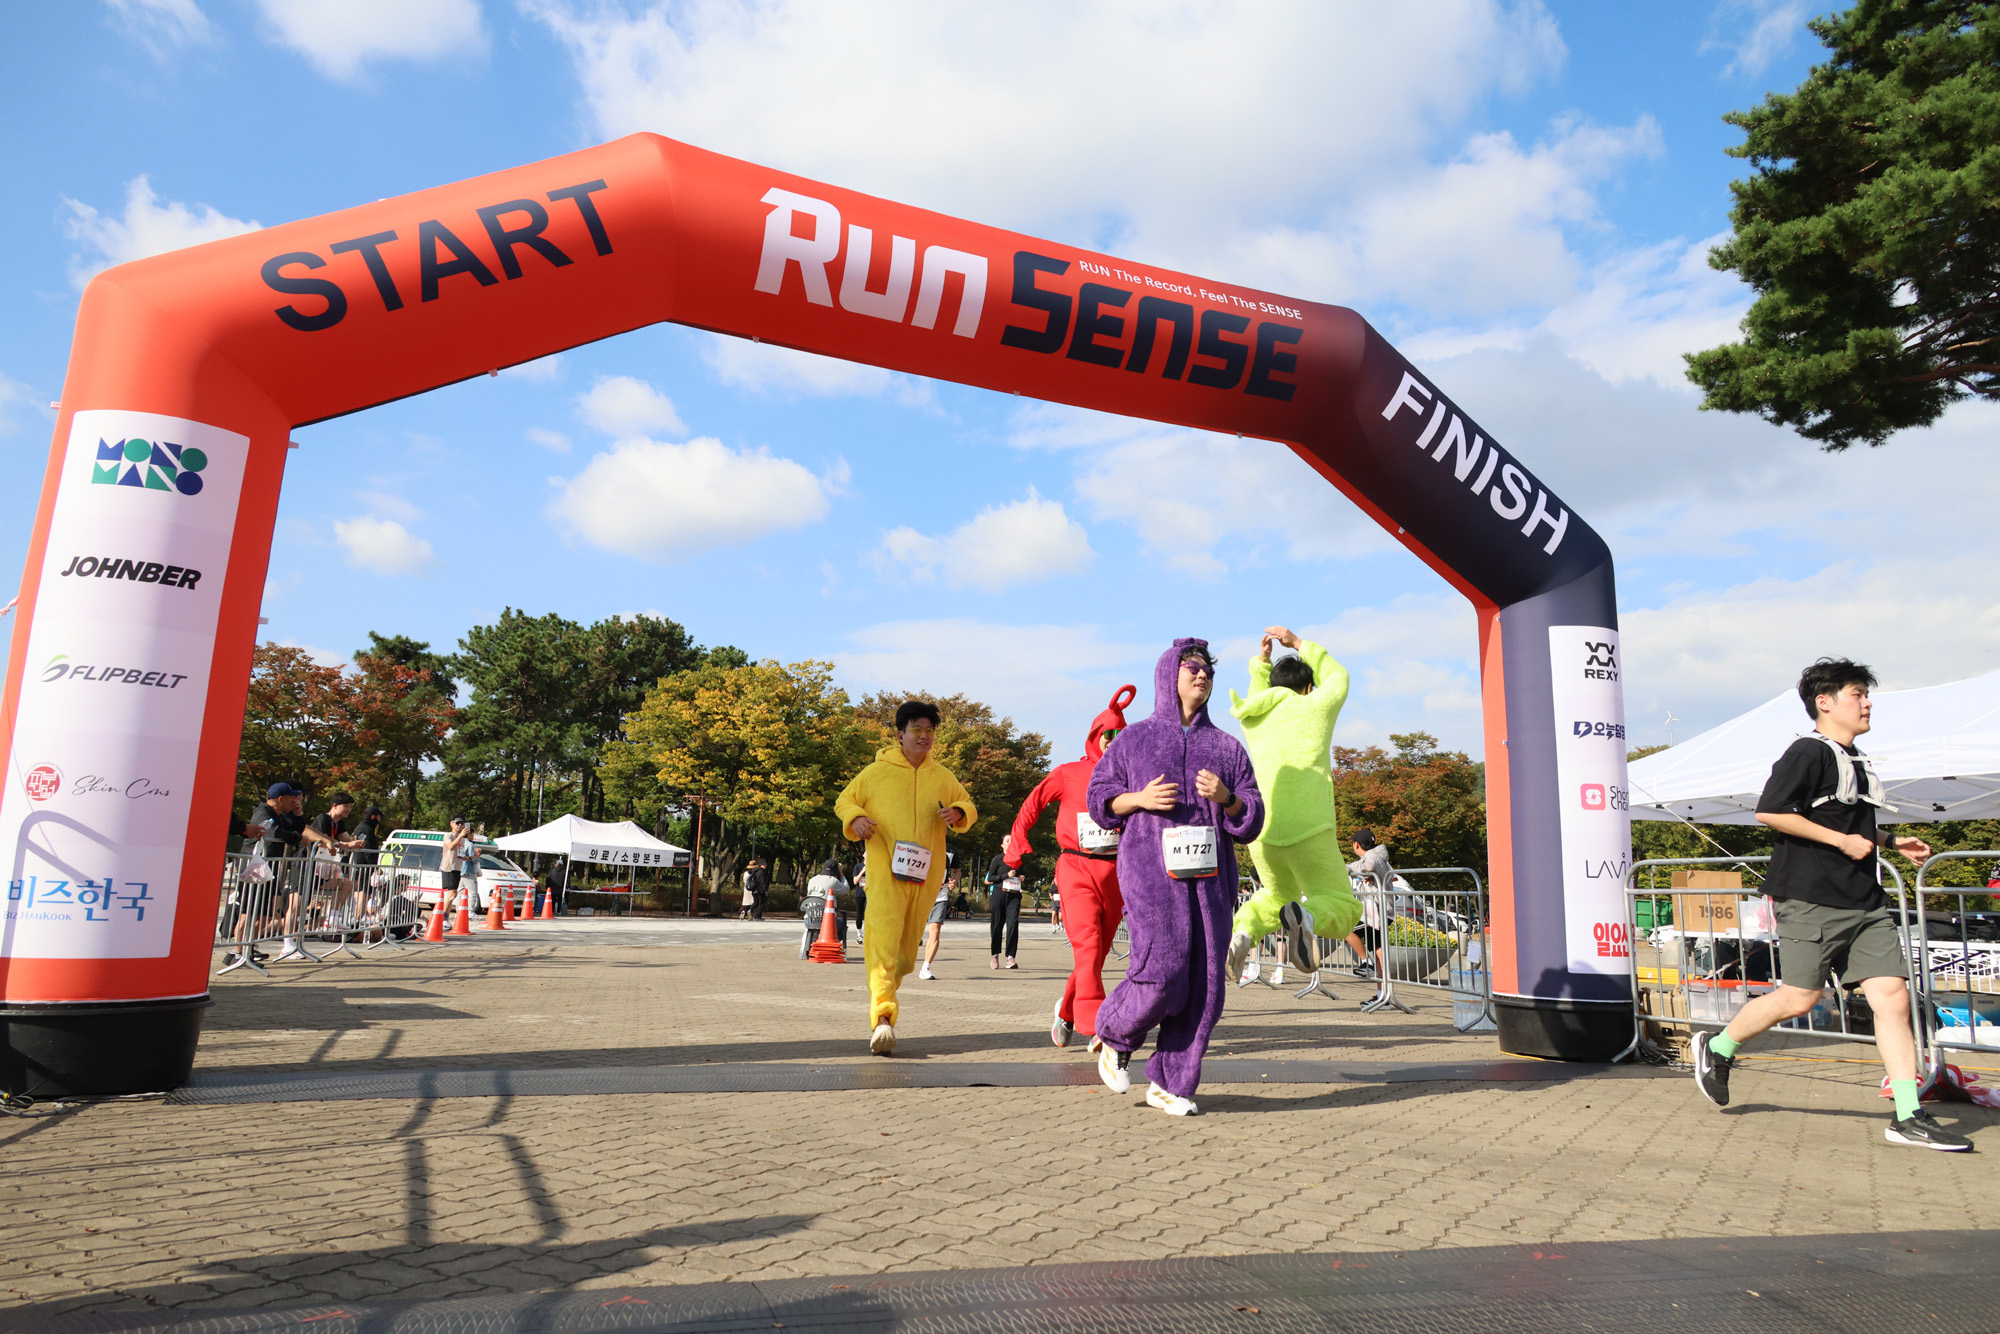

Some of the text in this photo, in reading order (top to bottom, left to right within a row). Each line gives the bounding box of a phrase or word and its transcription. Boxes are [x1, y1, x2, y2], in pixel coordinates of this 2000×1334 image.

[260, 178, 614, 332] START
[1079, 260, 1303, 320] RUN The Record, Feel The SENSE
[1381, 370, 1569, 556] FINISH
[61, 556, 202, 590] JOHNBER
[69, 665, 188, 689] FLIPBELT
[1584, 668, 1618, 682] REXY
[72, 775, 120, 795] Skin
[1173, 843, 1212, 855] M 1727
[906, 858, 926, 869] 1731
[7, 875, 154, 922] 비즈한국
[1699, 905, 1734, 920] 1986
